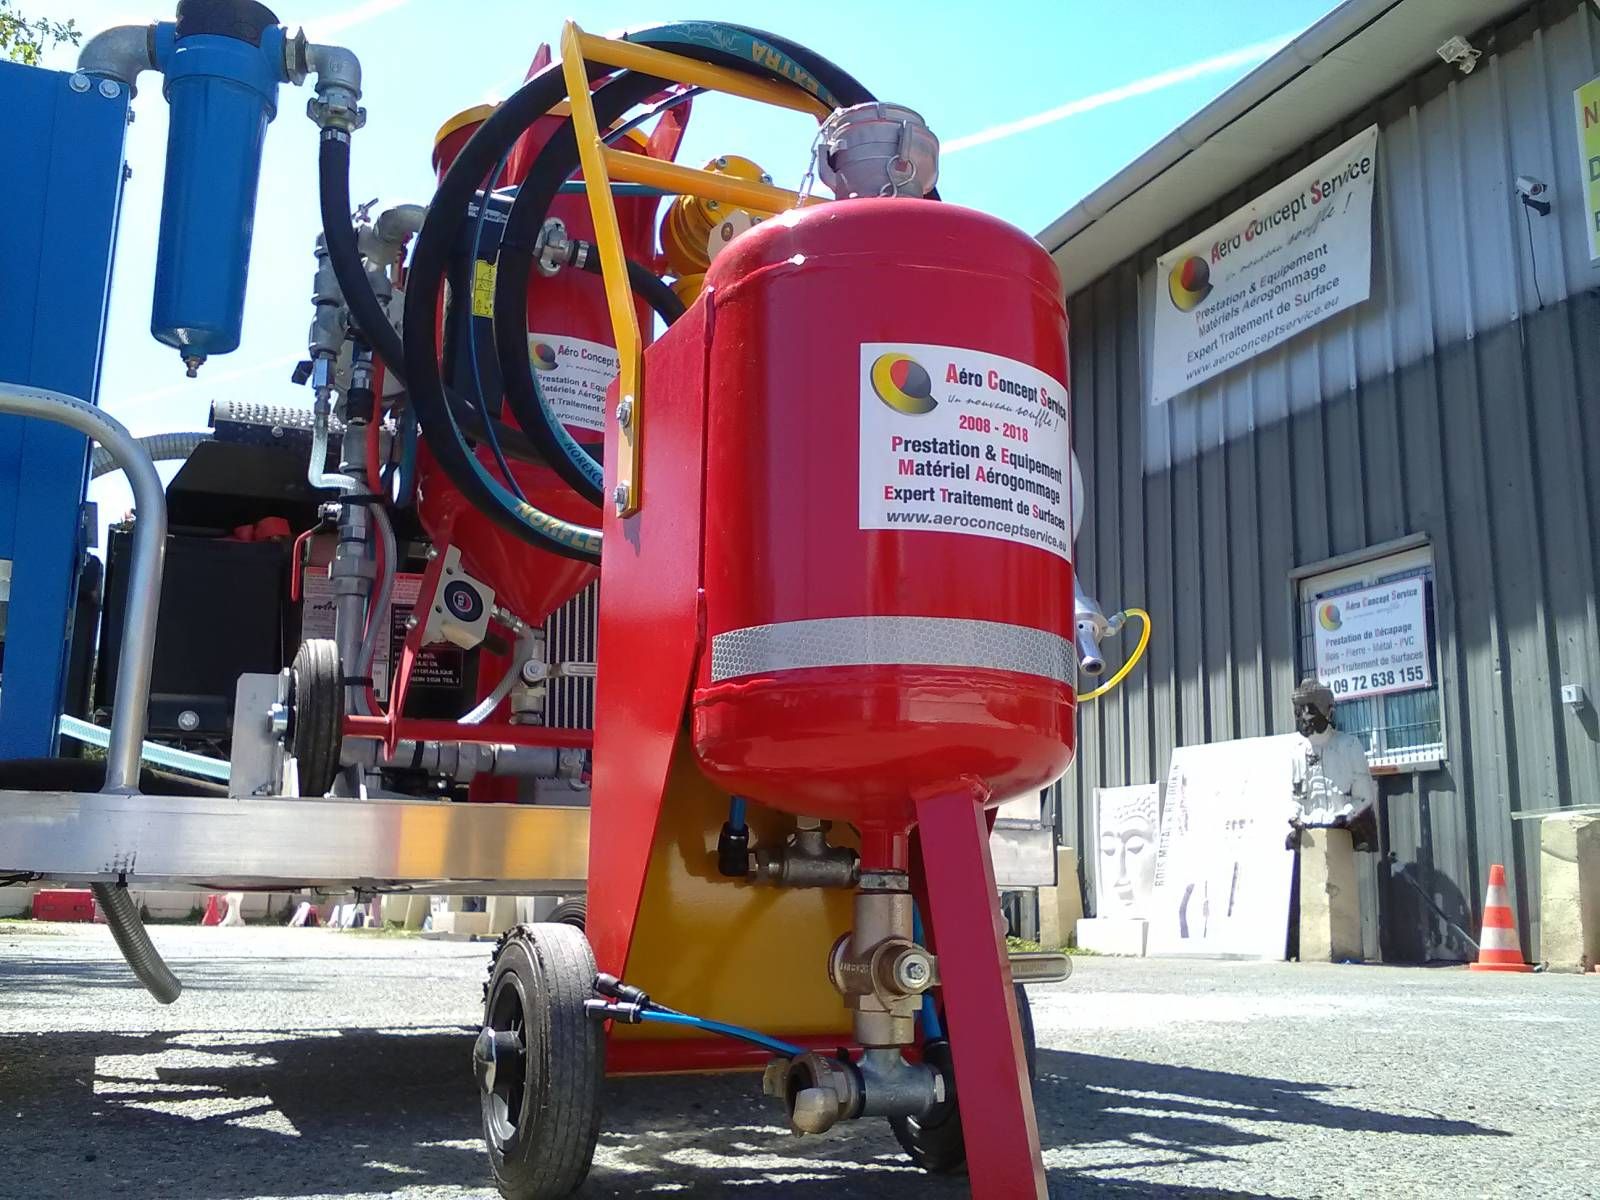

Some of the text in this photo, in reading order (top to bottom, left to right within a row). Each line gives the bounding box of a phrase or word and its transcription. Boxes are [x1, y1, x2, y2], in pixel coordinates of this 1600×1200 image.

[1245, 192, 1307, 242] Concept
[1311, 157, 1371, 205] Service
[1195, 243, 1328, 324] Prestation & Equipement
[1186, 276, 1340, 363] Expert Traitement de Surface
[557, 344, 579, 358] Aéro
[581, 348, 614, 367] Concept
[578, 391, 607, 403] Aérogo
[945, 363, 1067, 422] Aéro Concept Service
[966, 398, 1014, 412] nouveau
[959, 415, 991, 433] 2008
[1003, 422, 1029, 442] 2018
[891, 436, 1063, 485] Prestation & Equipement
[898, 459, 1061, 505] Matériel Aérogommage
[514, 502, 603, 552] NORFLE
[884, 486, 1066, 532] Expert Traitement de Surfaces
[886, 511, 1067, 552] www.aeroconceptservice.eu
[1391, 588, 1418, 600] Service
[1325, 633, 1362, 648] Prestation
[1363, 630, 1373, 639] de
[1334, 665, 1424, 694] 09 72 638 155
